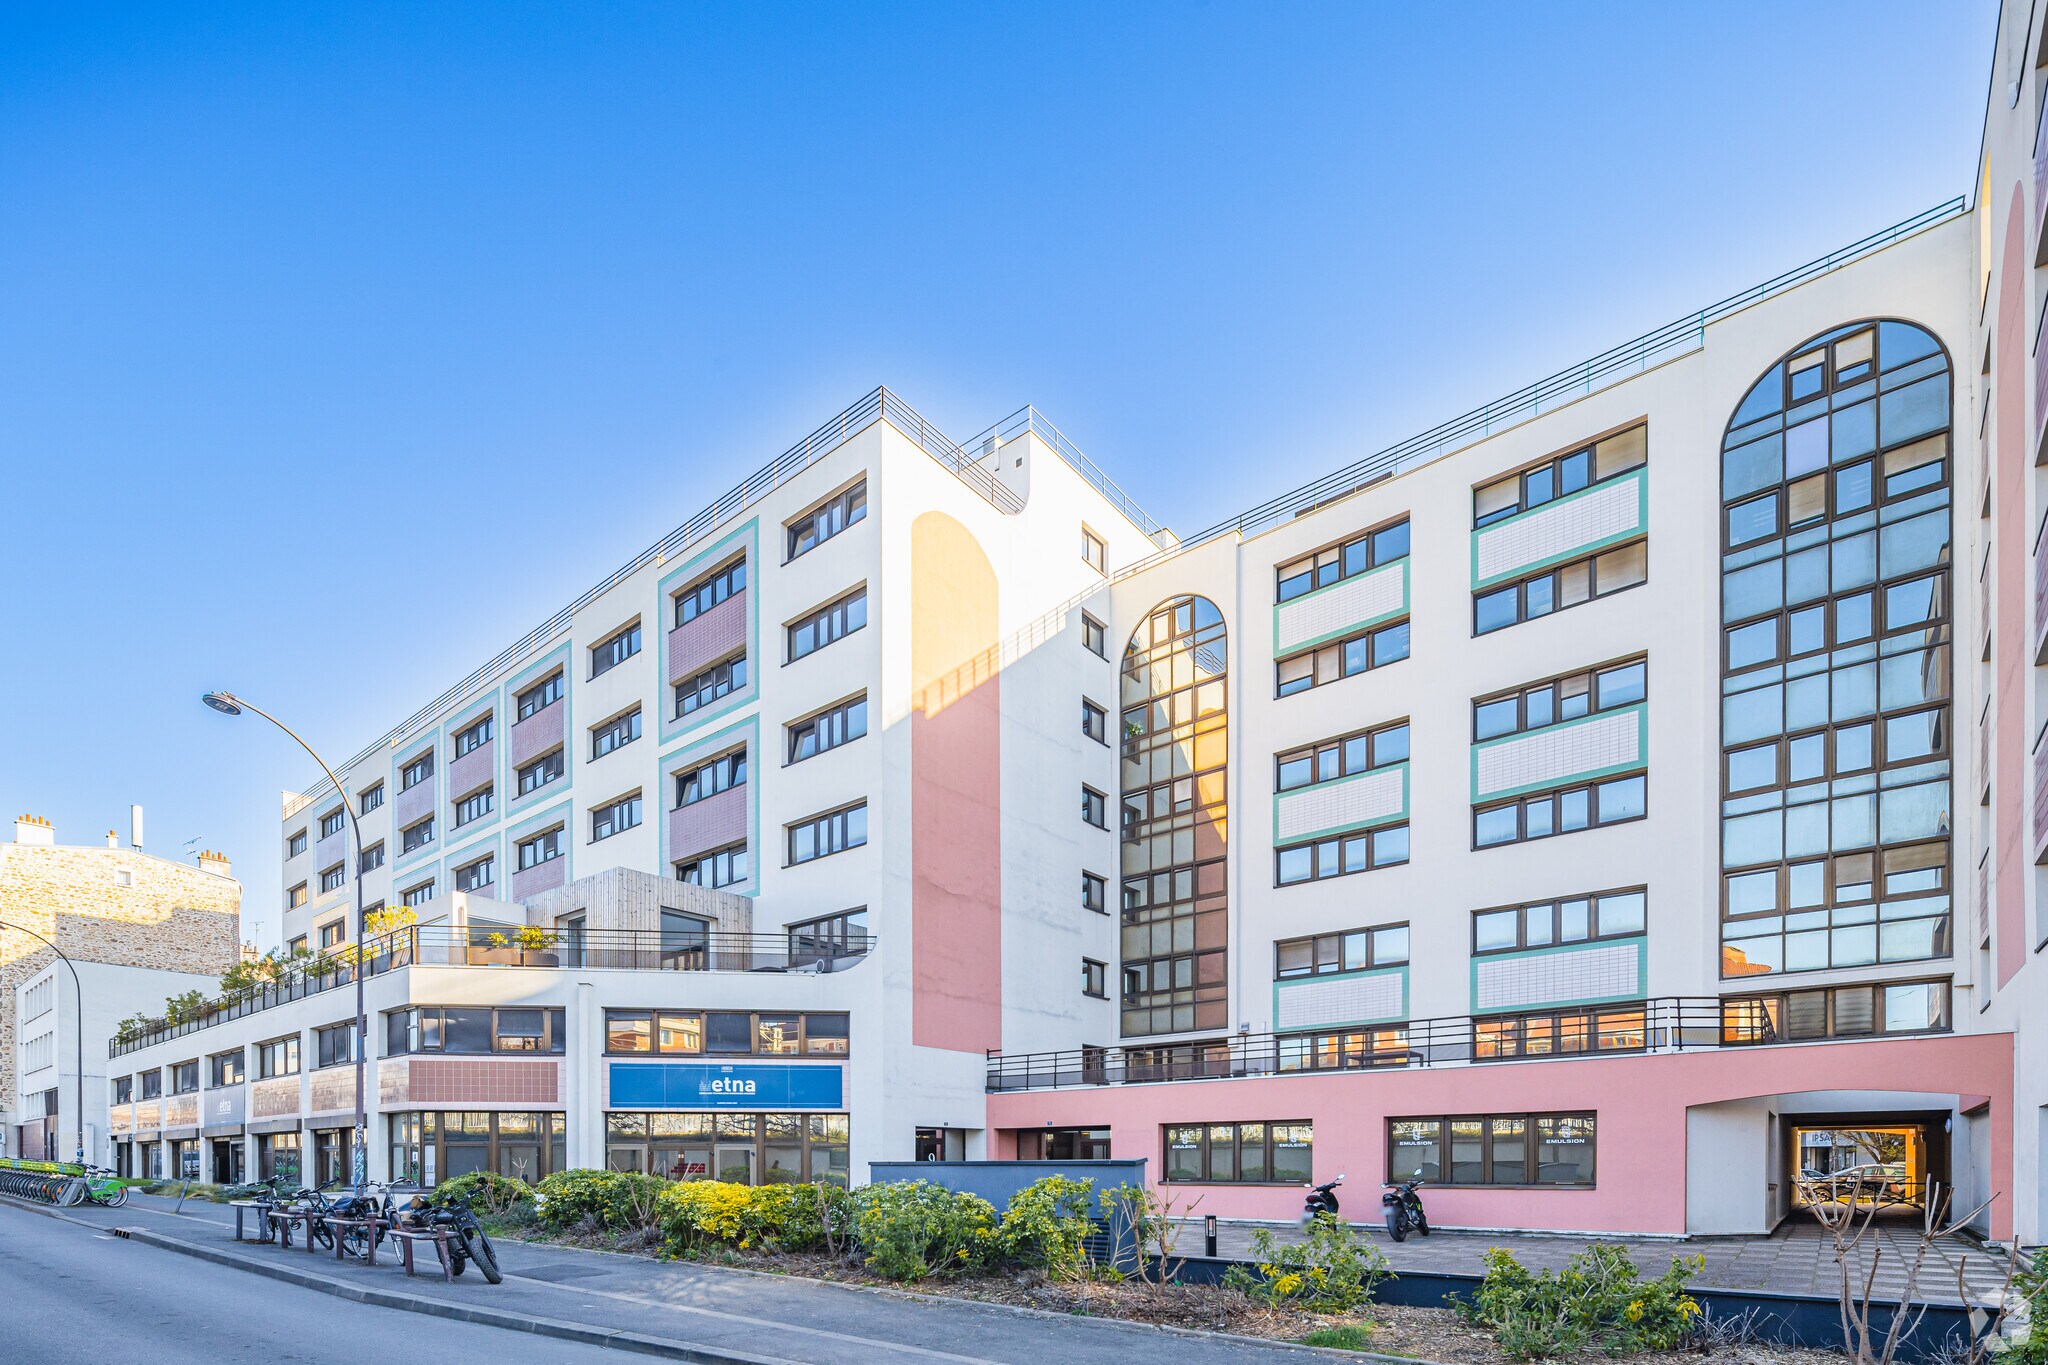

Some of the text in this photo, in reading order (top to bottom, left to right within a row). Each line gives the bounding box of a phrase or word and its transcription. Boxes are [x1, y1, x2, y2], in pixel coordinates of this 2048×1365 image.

[711, 1077, 756, 1092] etna
[220, 1099, 231, 1112] etna
[1811, 1133, 1831, 1142] IPSA
